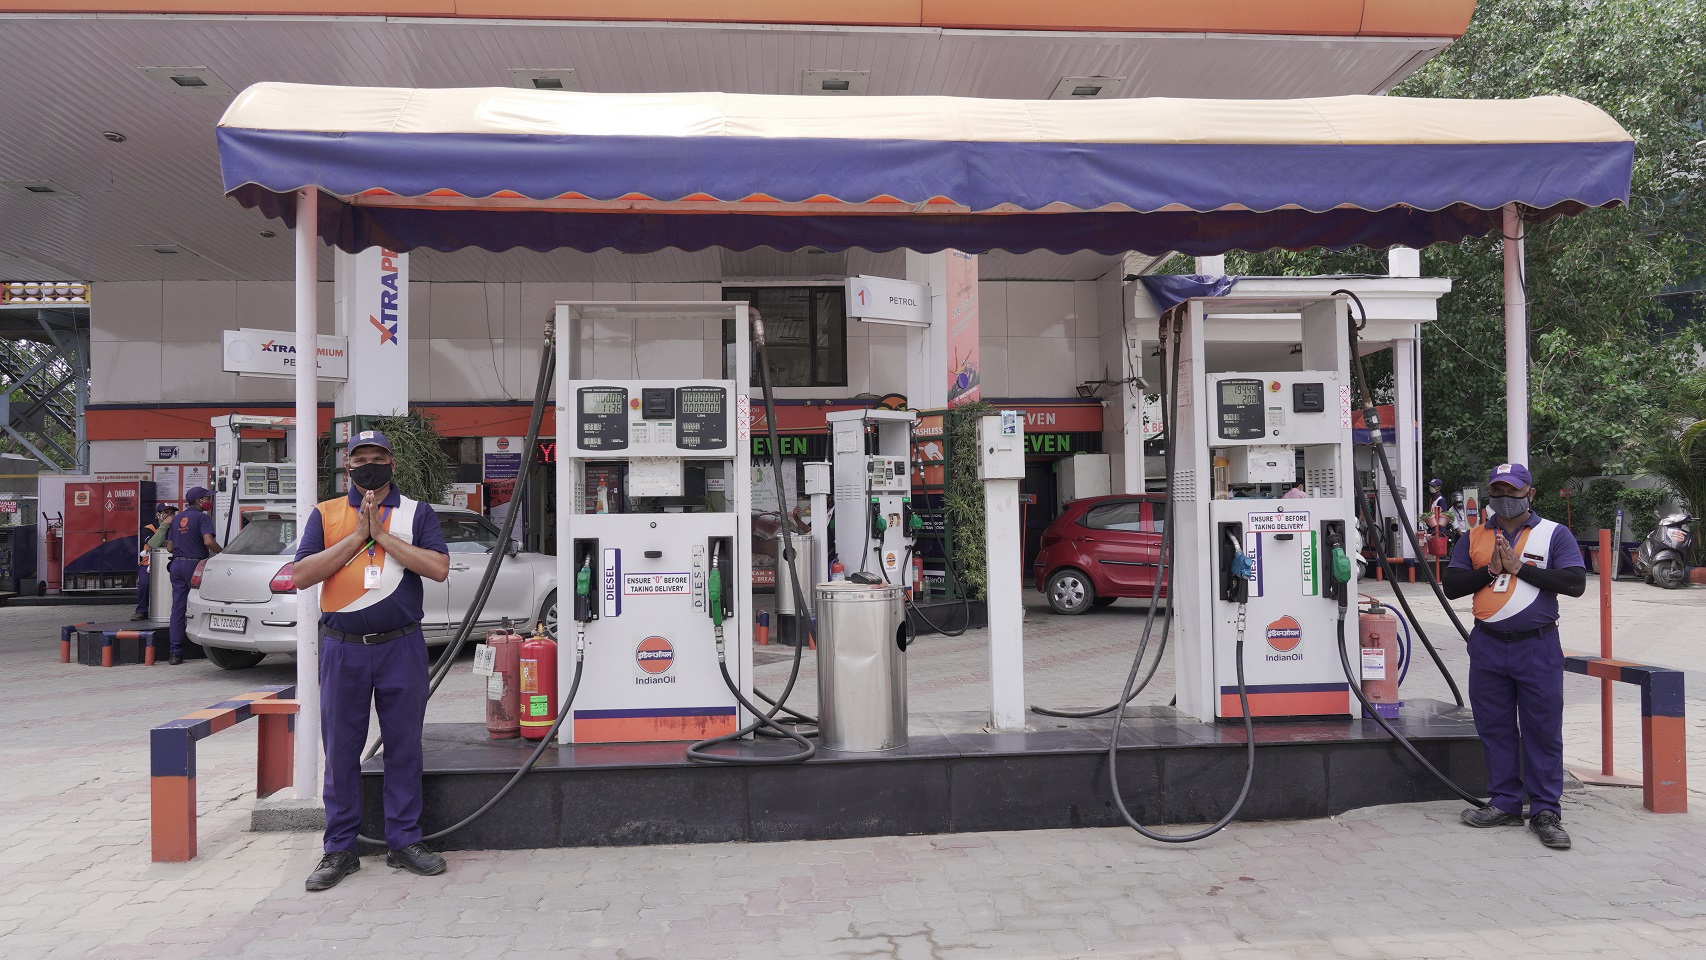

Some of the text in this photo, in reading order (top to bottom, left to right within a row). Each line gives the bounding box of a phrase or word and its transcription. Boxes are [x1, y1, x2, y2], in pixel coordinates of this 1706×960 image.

[857, 289, 865, 306] 1
[889, 296, 917, 307] PETROL
[261, 339, 344, 357] XTRAMIUM
[283, 358, 322, 369] PEL
[114, 489, 136, 498] DANGER
[1250, 515, 1273, 523] ENSURE
[1285, 514, 1307, 522] BEFORE
[1303, 544, 1312, 582] PETROL
[606, 565, 615, 601] DIESEL
[627, 577, 652, 585] ENSURE
[664, 576, 688, 584] BEFORE
[631, 584, 684, 593] TAKING DELIVERY
[1265, 653, 1303, 662] IndianOil
[635, 675, 676, 685] IndianOil
